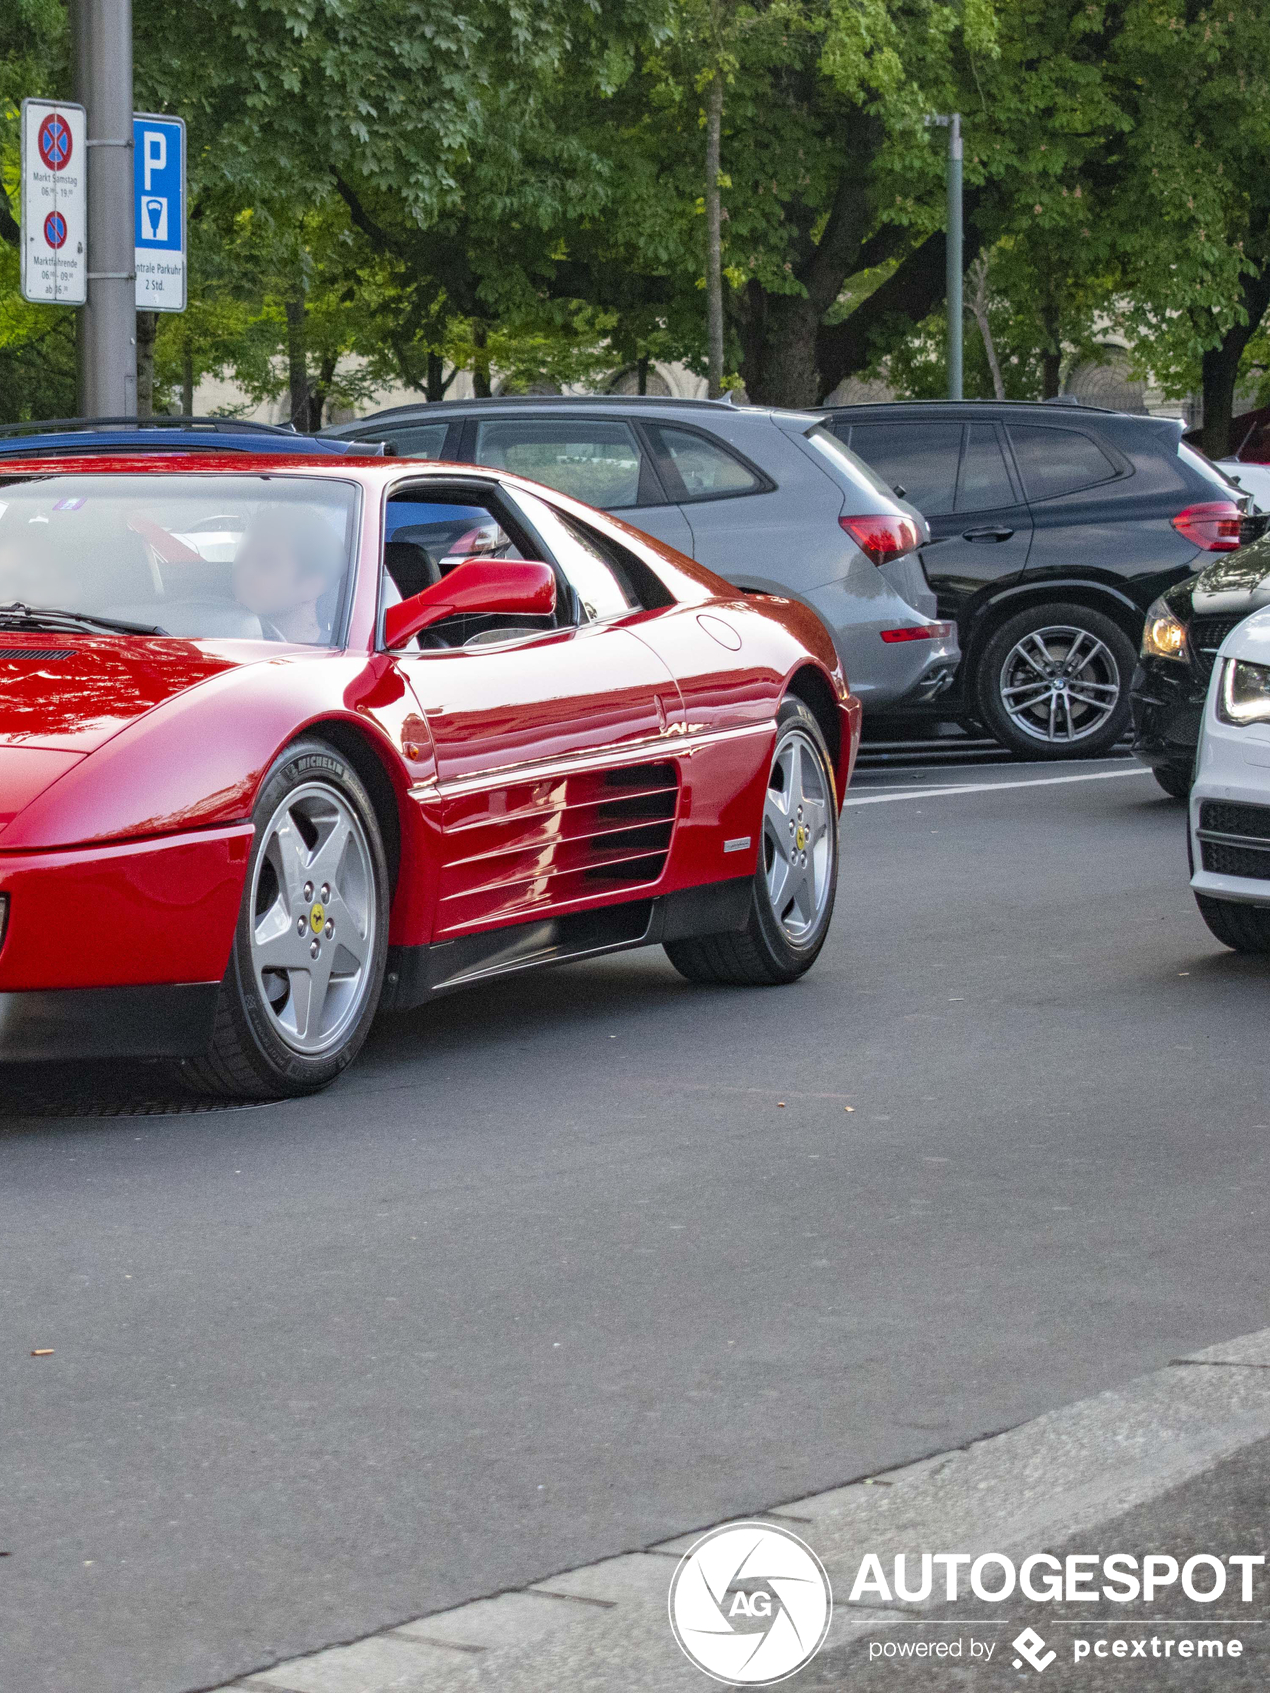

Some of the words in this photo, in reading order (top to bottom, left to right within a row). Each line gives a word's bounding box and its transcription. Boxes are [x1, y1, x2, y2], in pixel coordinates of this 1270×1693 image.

[144, 131, 166, 190] P
[33, 172, 51, 182] Markt
[52, 174, 77, 187] Samstag
[33, 256, 77, 268] Marktfahrende
[135, 263, 155, 273] ntrale
[157, 264, 181, 275] Parkuhr
[45, 285, 52, 294] ab
[145, 280, 149, 290] 2
[151, 280, 164, 290] Std.
[298, 756, 343, 776] MICHELIN
